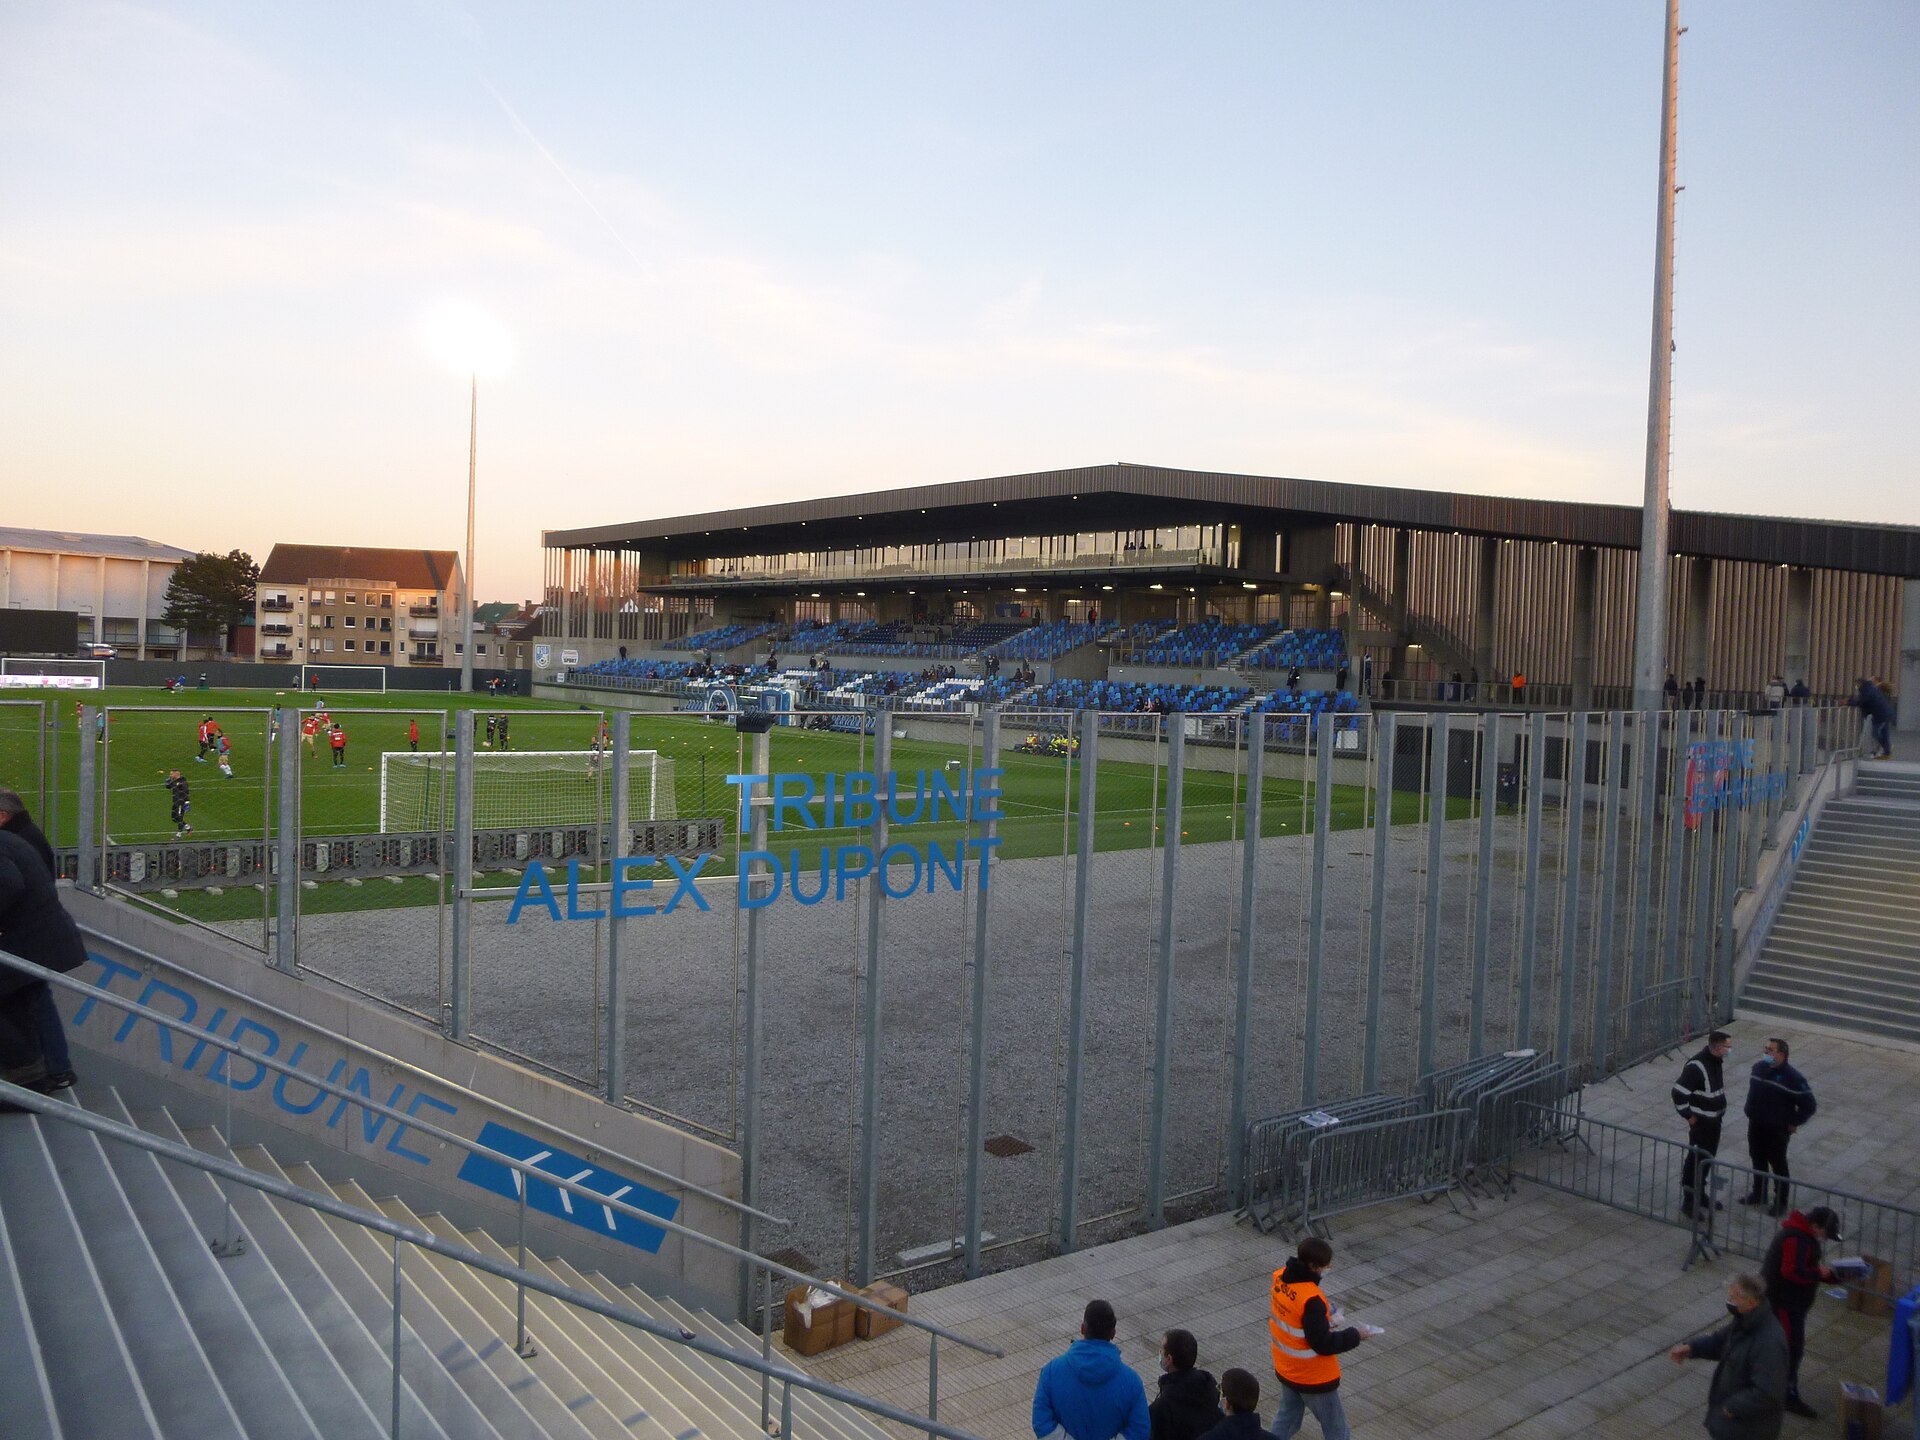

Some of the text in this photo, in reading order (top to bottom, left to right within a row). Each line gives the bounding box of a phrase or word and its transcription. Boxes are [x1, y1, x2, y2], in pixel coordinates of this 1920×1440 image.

[726, 769, 1005, 833] TRIBUNE
[506, 838, 1003, 925] ALEX DUPONT
[72, 952, 458, 1165] TRIBUNE
